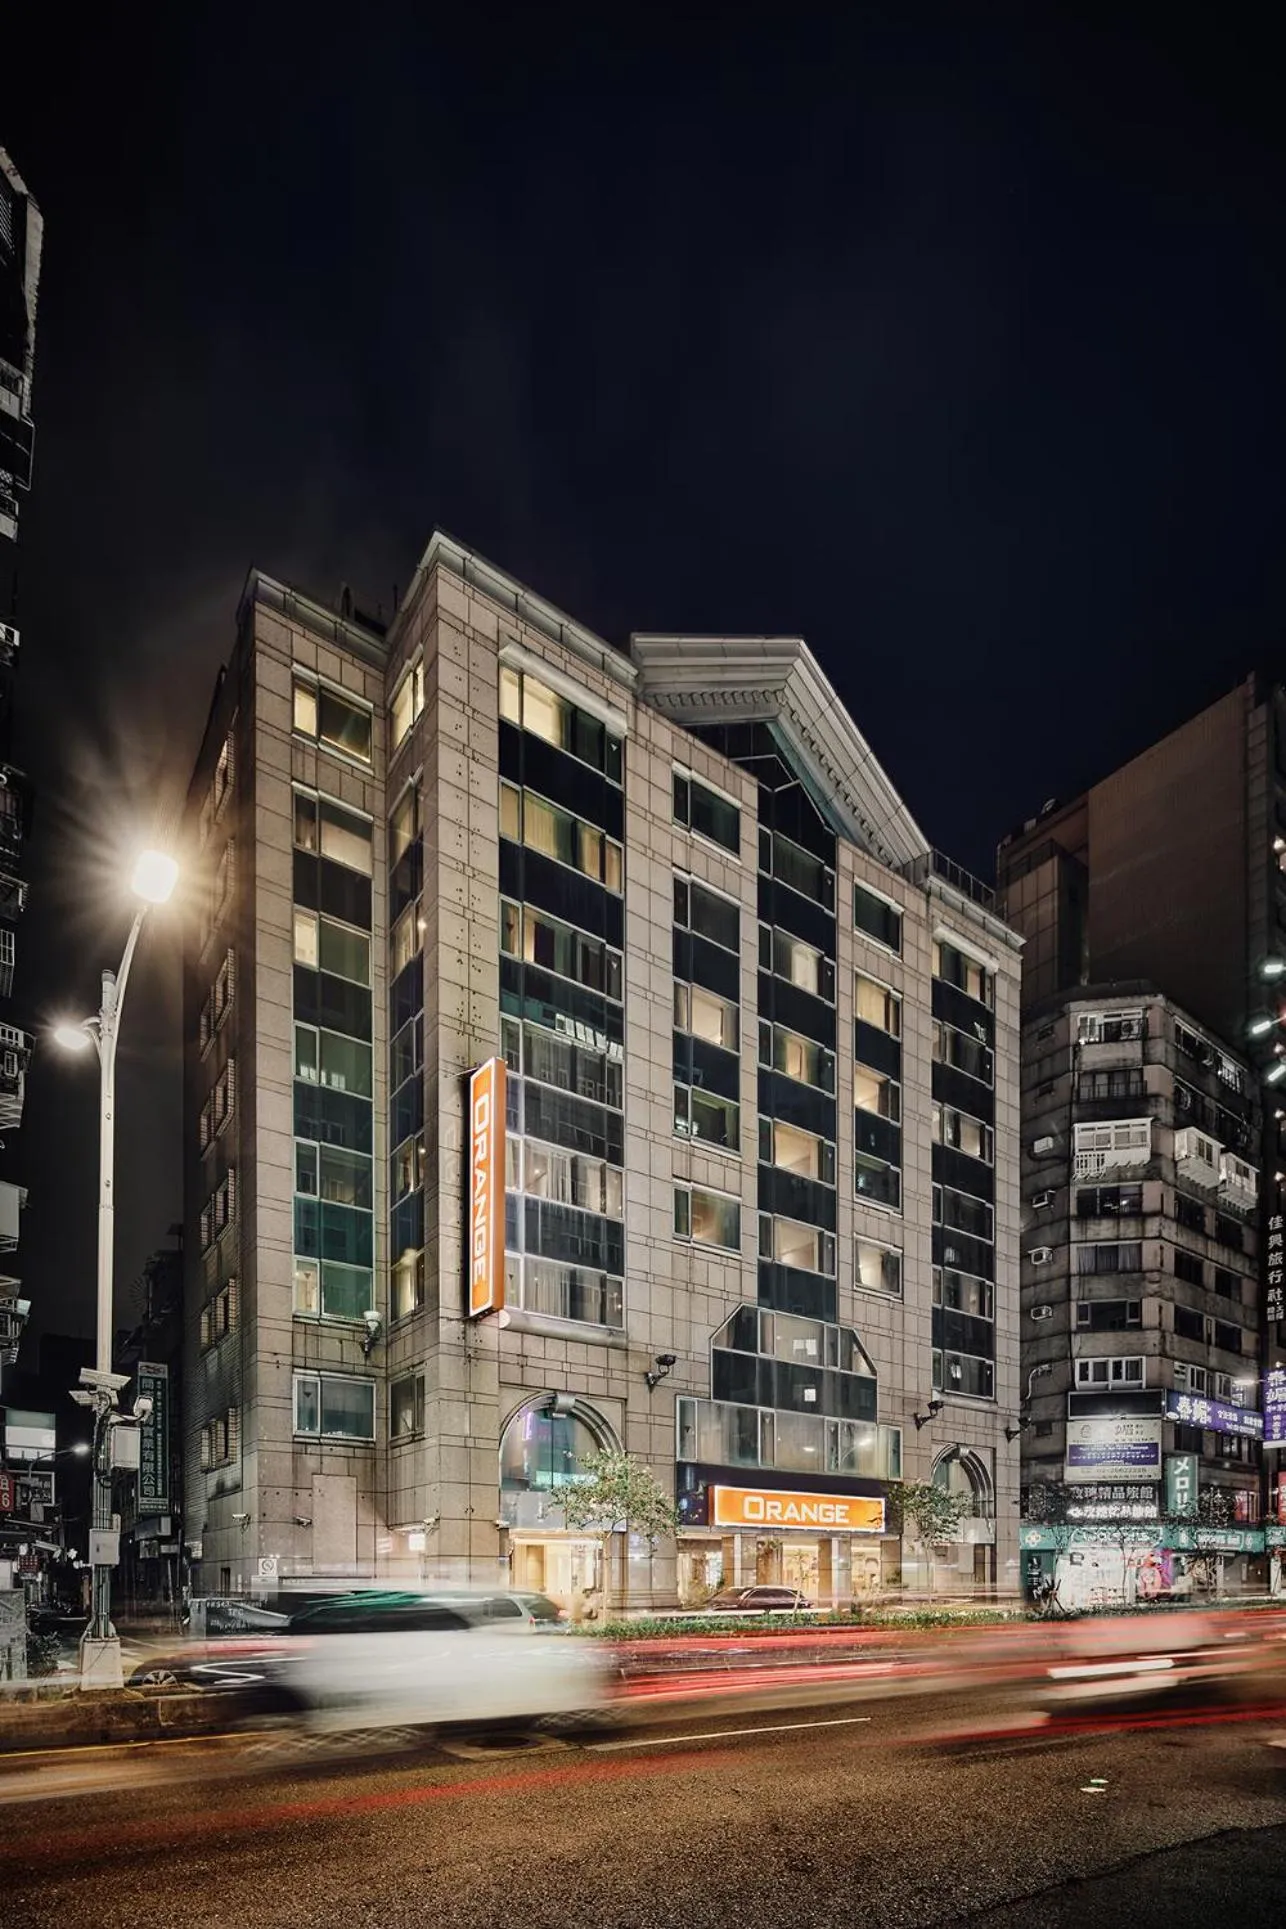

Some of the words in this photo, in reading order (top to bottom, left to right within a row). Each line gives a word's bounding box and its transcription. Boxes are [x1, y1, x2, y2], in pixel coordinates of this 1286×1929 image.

[474, 1094, 490, 1285] ORANGE
[1268, 1215, 1284, 1302] 佳興旅行社
[743, 1496, 849, 1523] ORANGE
